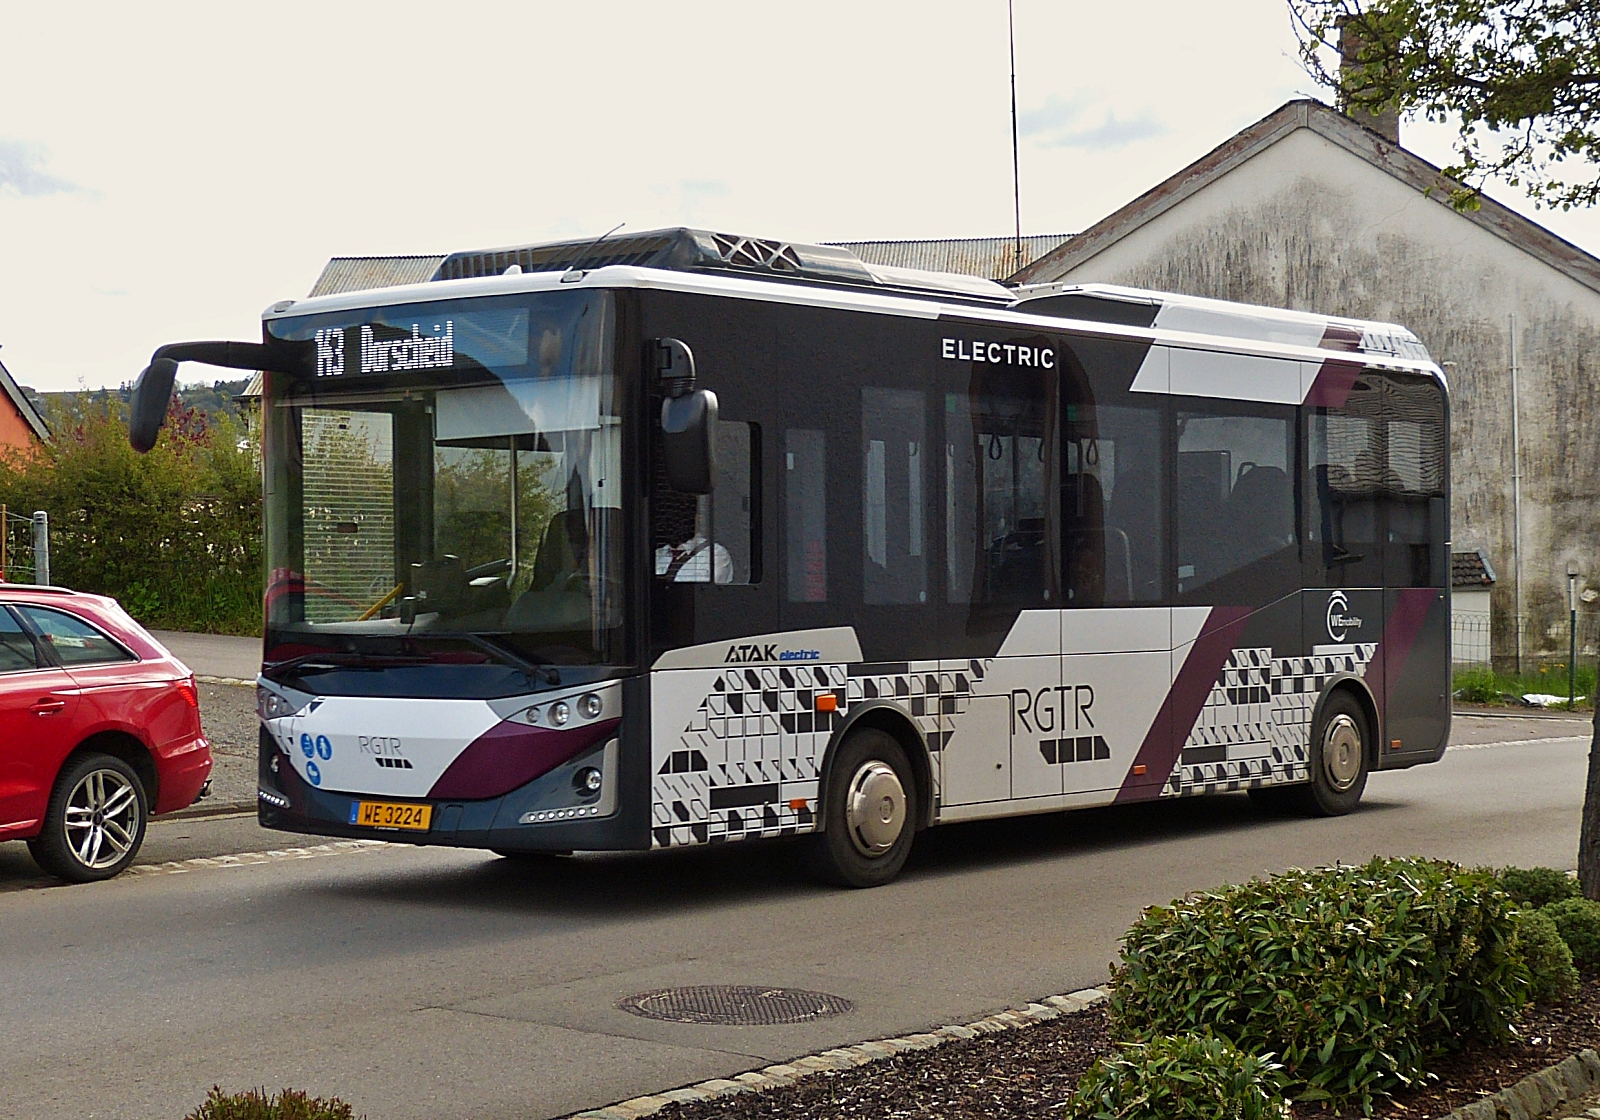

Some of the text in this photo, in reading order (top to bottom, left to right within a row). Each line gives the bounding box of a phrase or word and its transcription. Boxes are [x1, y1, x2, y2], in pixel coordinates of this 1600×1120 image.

[360, 320, 454, 373] Dorscheid
[942, 338, 1054, 369] ELECTRIC
[724, 644, 820, 663] ATAK electric
[1012, 684, 1095, 736] RGTR
[358, 735, 402, 755] RGTR
[363, 804, 423, 826] WE 3224
